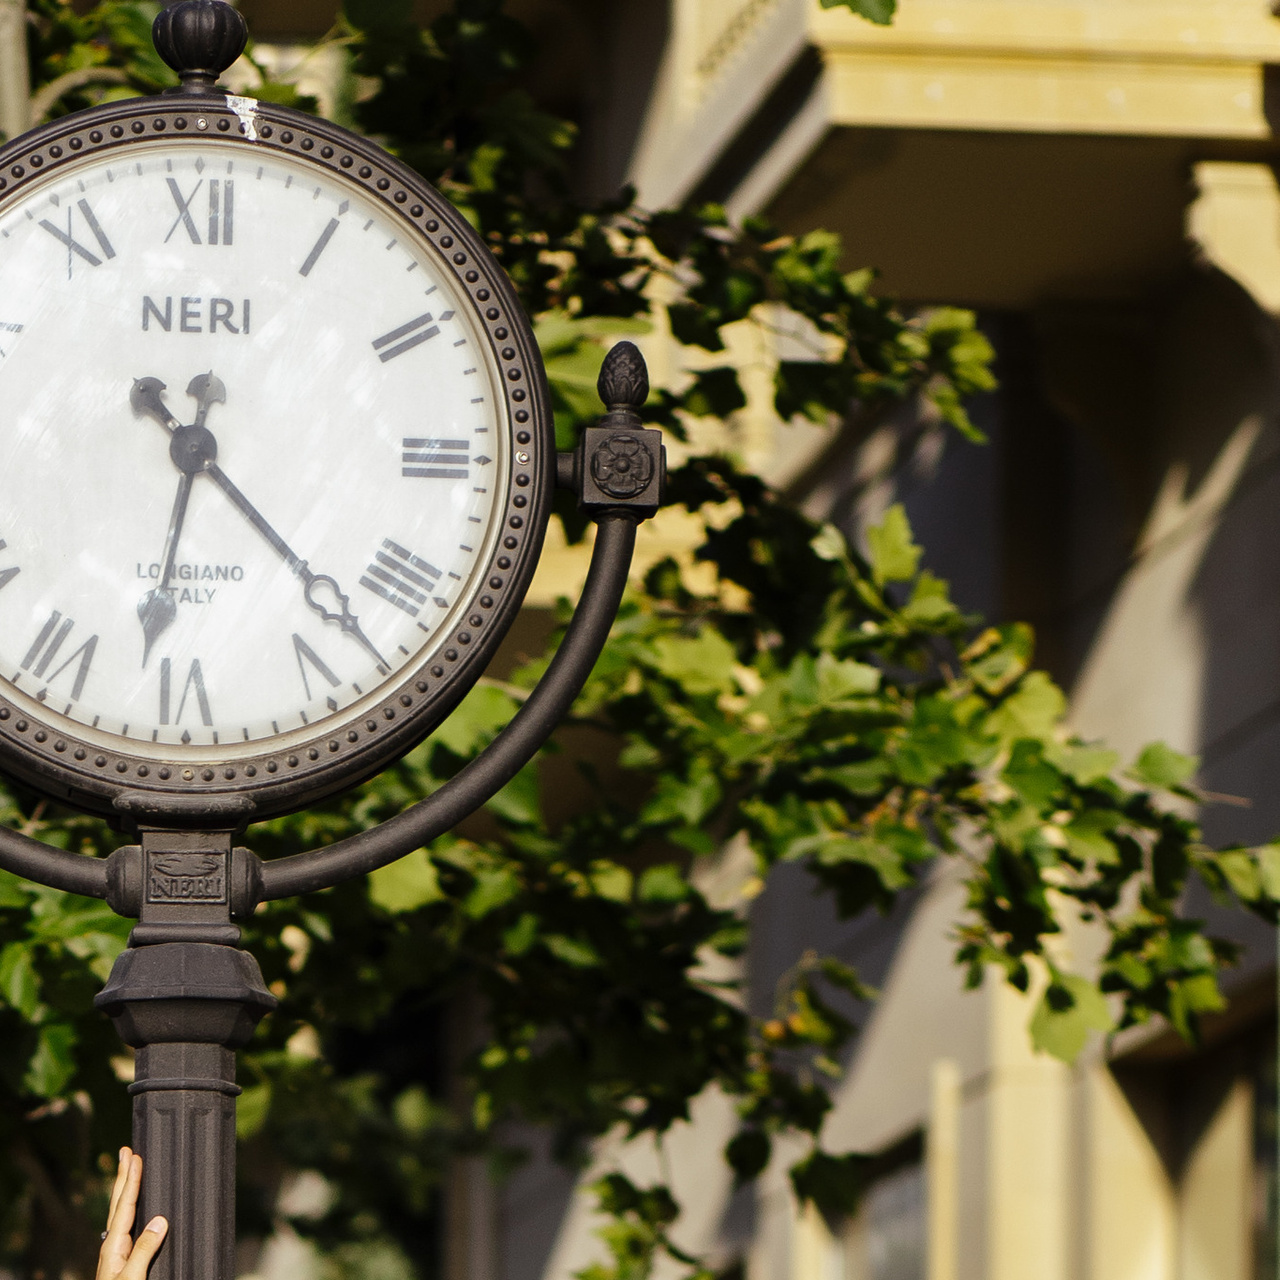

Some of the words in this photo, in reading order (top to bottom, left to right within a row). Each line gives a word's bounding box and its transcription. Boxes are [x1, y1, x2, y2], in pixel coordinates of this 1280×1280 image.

[39, 199, 116, 280] XI
[164, 178, 234, 245] XII
[299, 218, 340, 277] I
[141, 295, 251, 334] NERI
[371, 312, 440, 362] II
[402, 437, 470, 479] III
[162, 587, 216, 604] TALY
[359, 537, 443, 617] IIII
[21, 610, 99, 701] VII
[292, 633, 342, 700] V
[159, 657, 213, 727] VI
[150, 877, 222, 898] NERI
